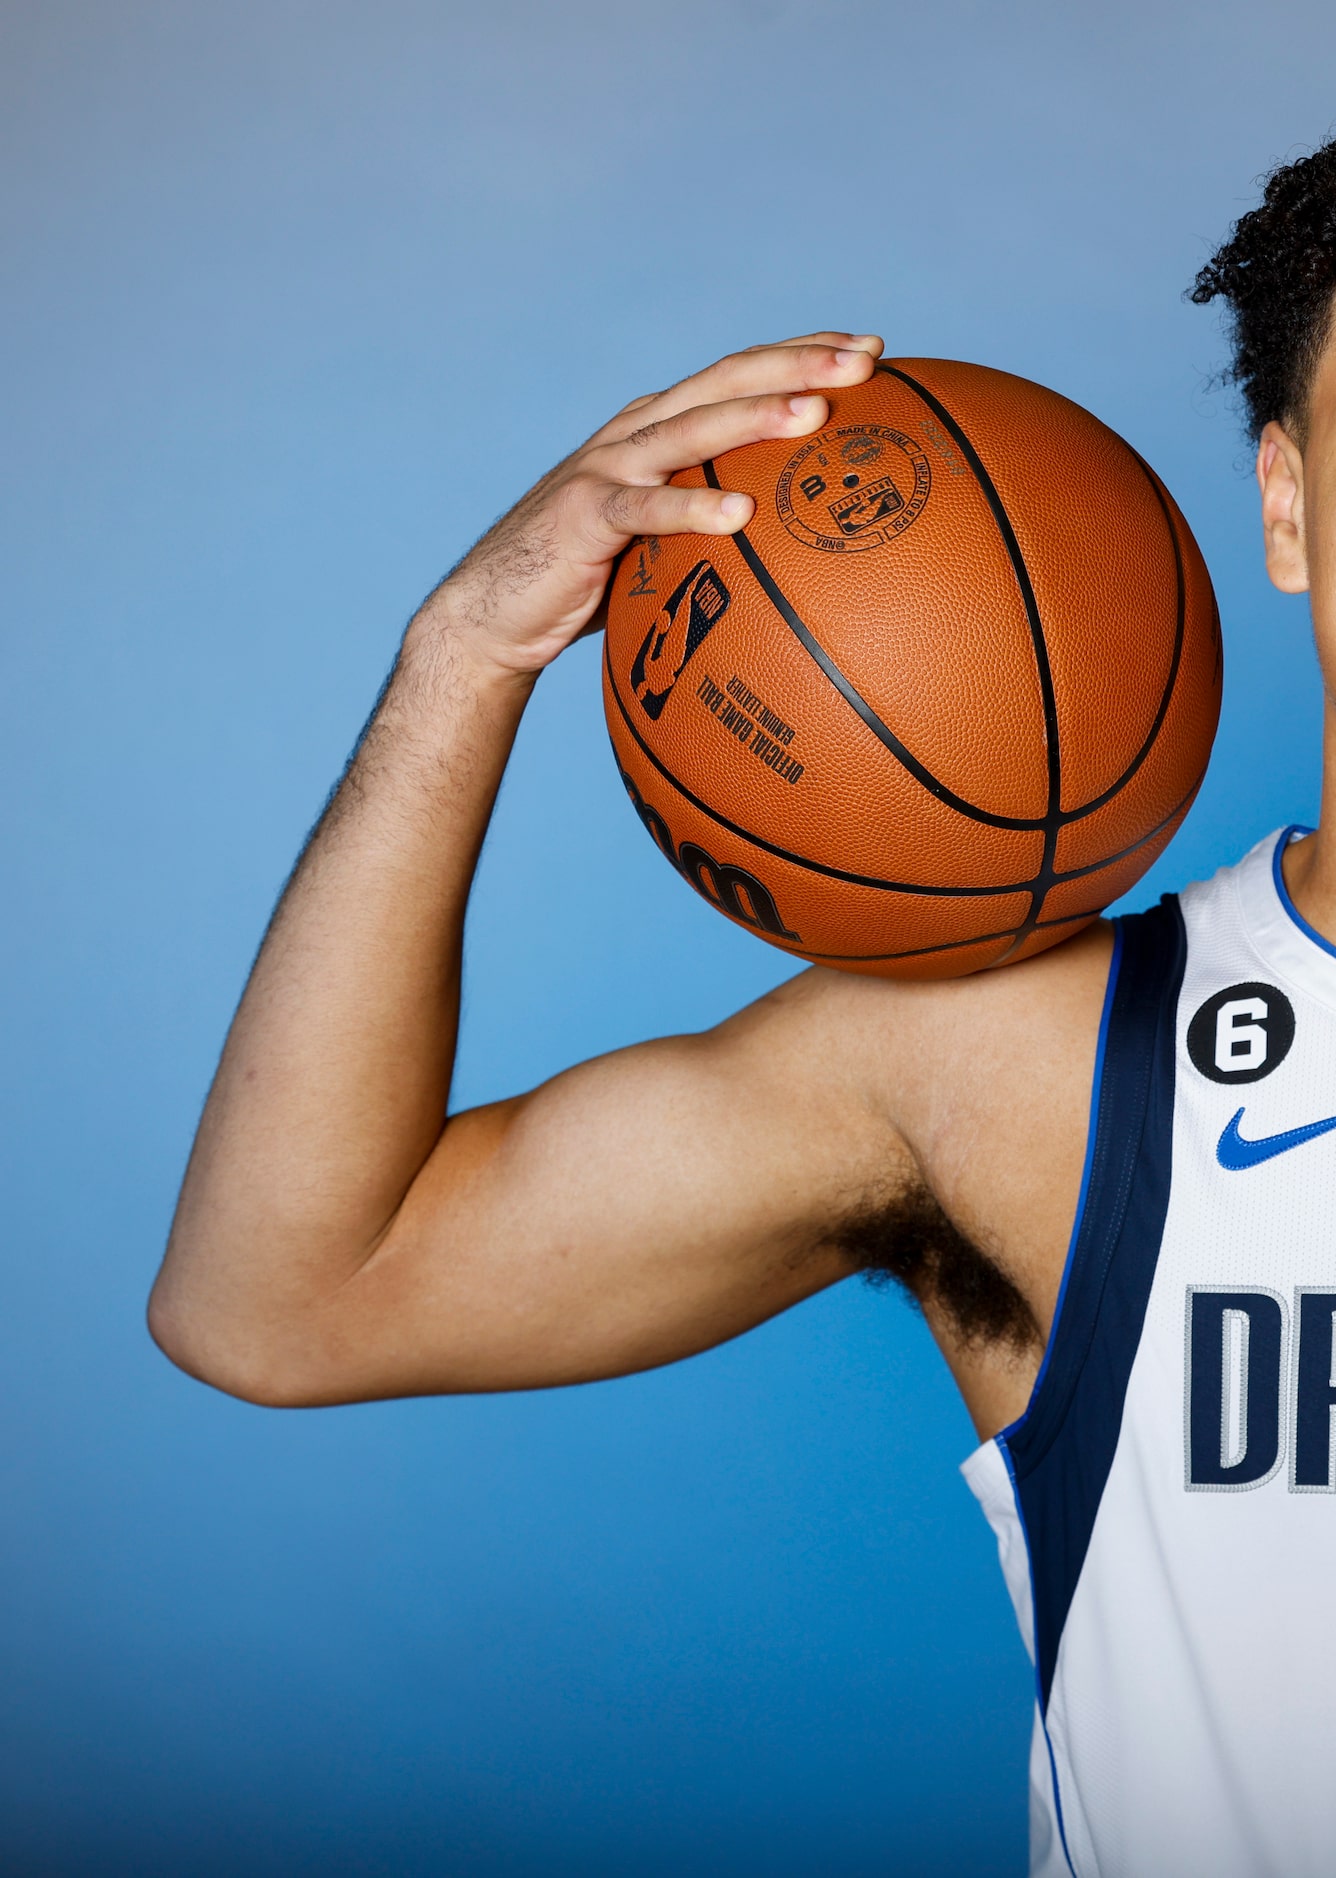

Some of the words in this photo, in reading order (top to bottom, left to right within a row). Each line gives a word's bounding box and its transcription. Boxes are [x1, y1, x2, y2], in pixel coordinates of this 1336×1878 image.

[836, 426, 866, 436] MADE
[869, 427, 880, 435] IN
[882, 429, 910, 447] CHINA
[779, 471, 790, 514] DESIGNED
[788, 460, 799, 469] IN
[798, 444, 815, 460] USA
[916, 462, 926, 496] INFLATE
[893, 515, 909, 532] PSI
[906, 509, 915, 517] 8
[912, 498, 923, 509] TO
[815, 536, 846, 549] @NBA
[694, 578, 725, 620] NBA
[695, 674, 726, 715] BALL
[725, 675, 762, 716] LEATHER
[717, 700, 754, 743] GAME
[755, 705, 796, 746] GENUINE
[748, 729, 805, 785] OFFICIAL
[1213, 997, 1270, 1073] 6
